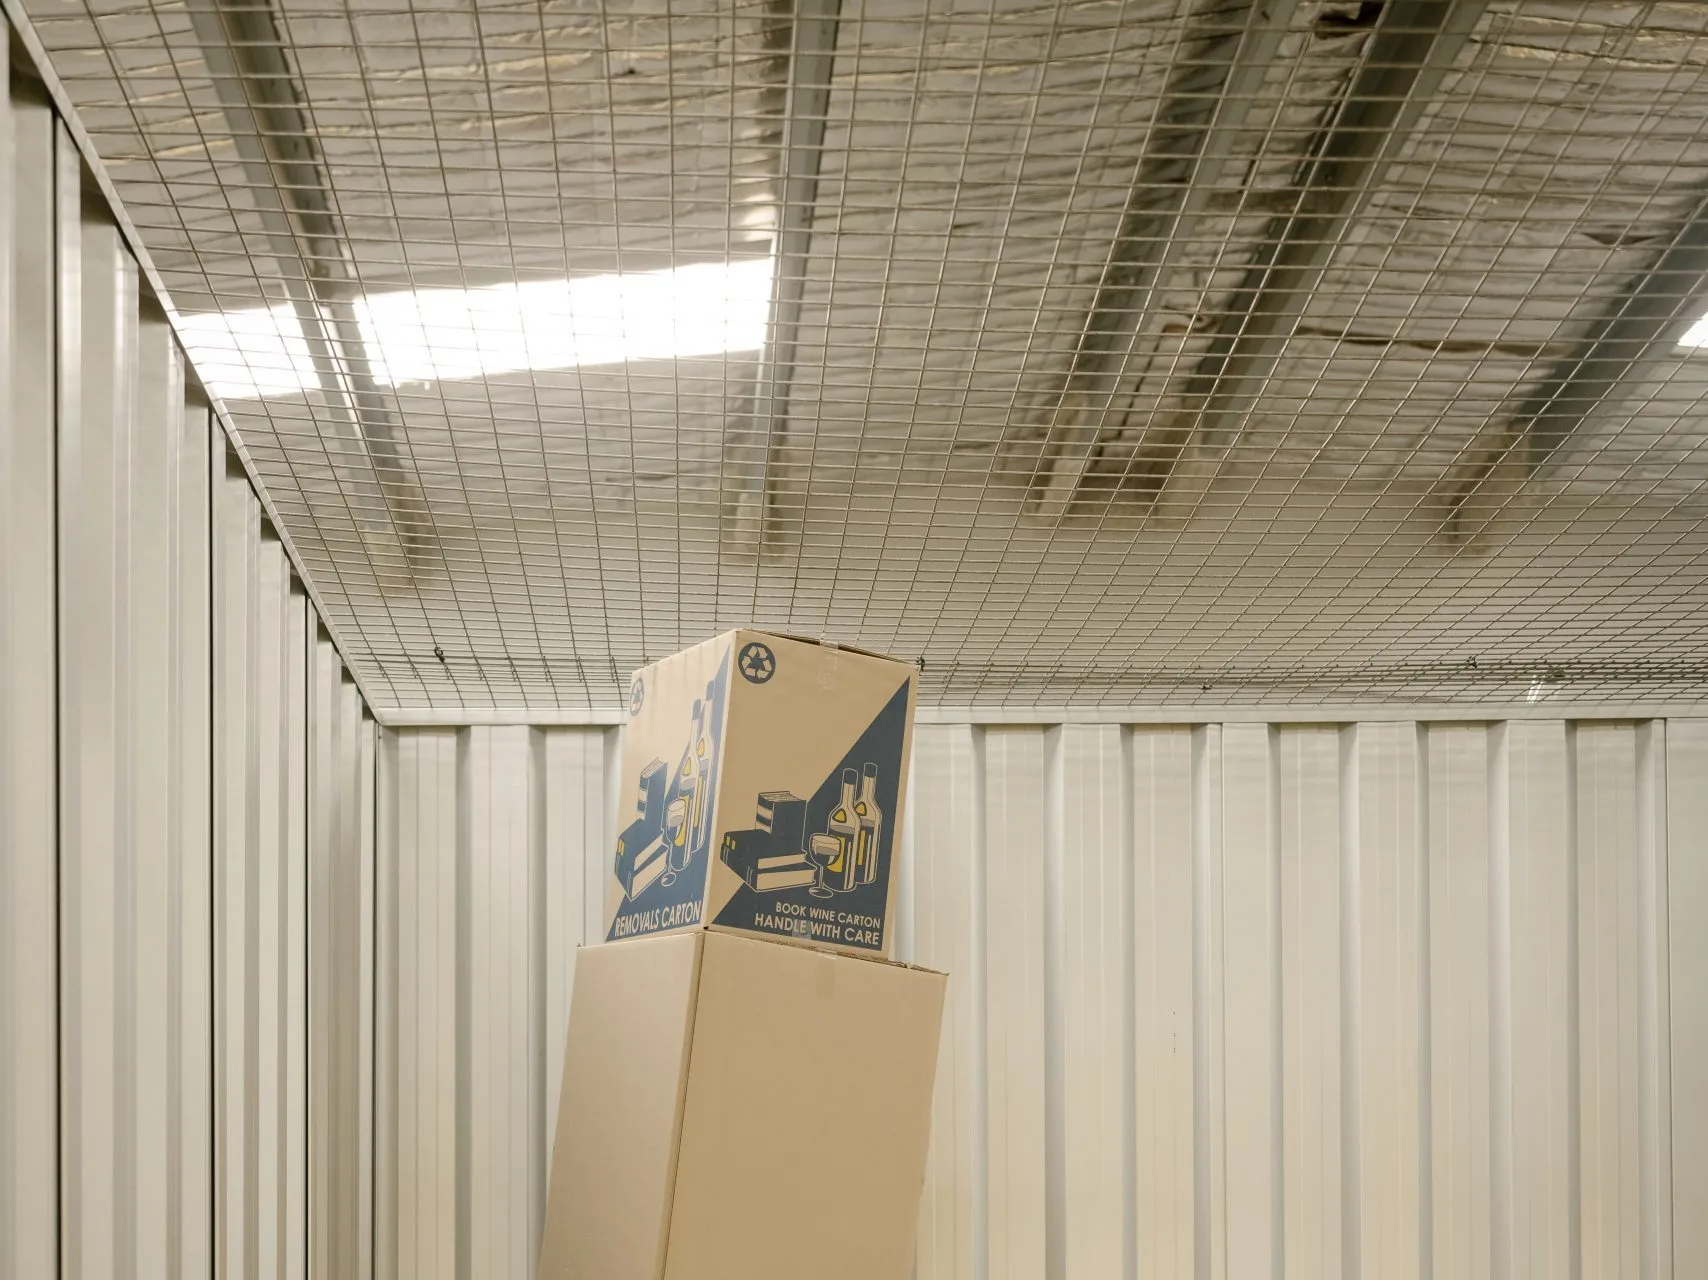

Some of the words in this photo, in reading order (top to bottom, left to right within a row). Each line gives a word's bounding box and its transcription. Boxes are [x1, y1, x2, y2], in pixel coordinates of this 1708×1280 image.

[614, 908, 660, 937] REMOVALS
[661, 899, 701, 927] CARTON
[754, 912, 807, 934] HANDLE
[810, 921, 841, 939] WITH
[844, 927, 880, 945] CARE
[775, 901, 807, 917] BOOK
[809, 907, 836, 922] WINE
[837, 912, 881, 929] CARTON
